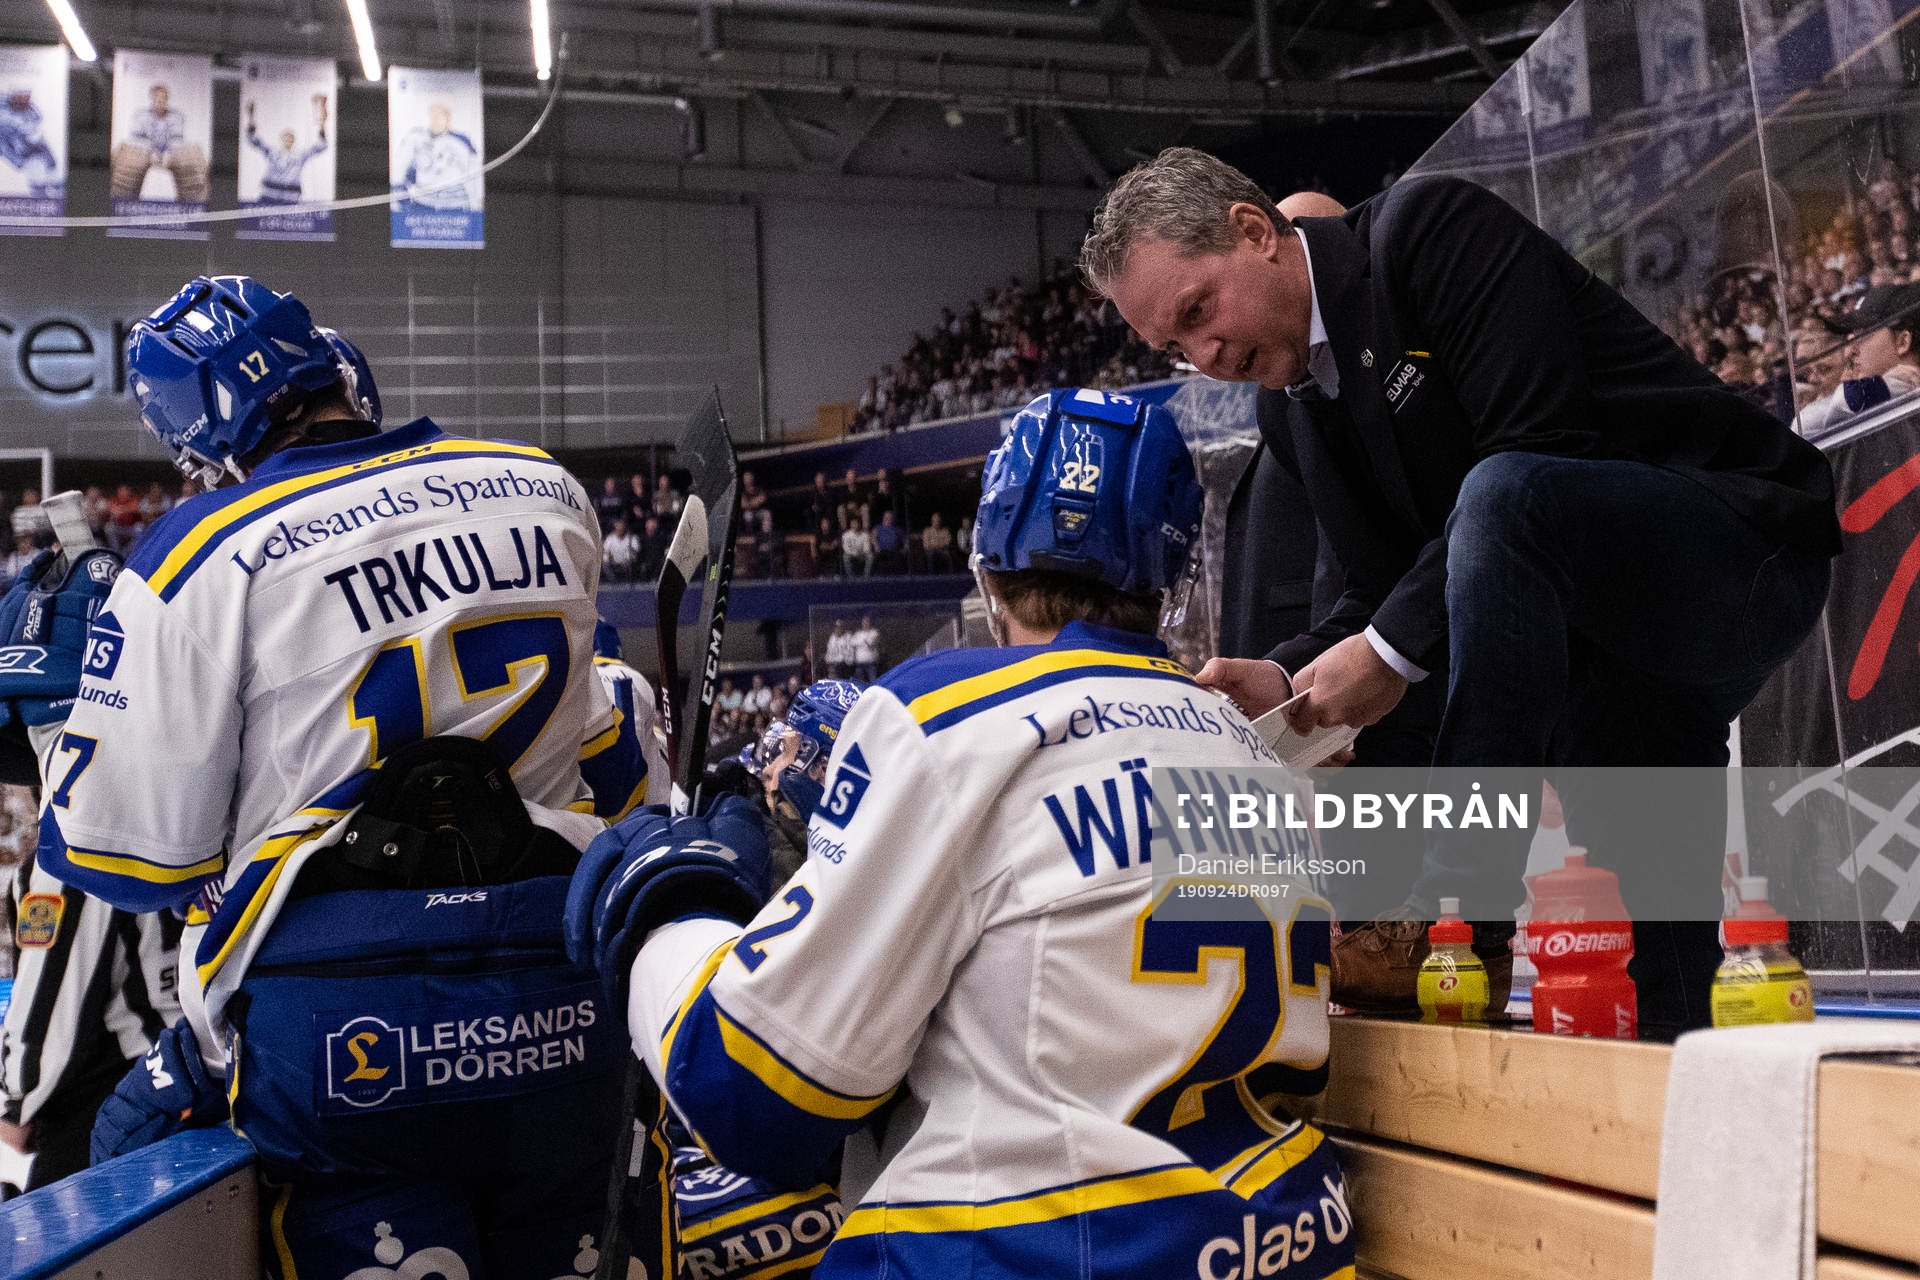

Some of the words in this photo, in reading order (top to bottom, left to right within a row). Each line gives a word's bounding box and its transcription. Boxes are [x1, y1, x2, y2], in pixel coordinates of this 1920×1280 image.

[238, 350, 270, 383] 17
[1386, 363, 1417, 402] ELMAB
[181, 412, 208, 443] CCM
[1058, 460, 1101, 494] 22
[230, 487, 420, 577] Leksands
[422, 469, 584, 515] Sparbank
[323, 525, 568, 634] TRKULJA
[702, 628, 722, 706] CCM
[346, 610, 571, 777] 17
[661, 686, 673, 735] CCM
[1021, 696, 1222, 748] Leksands
[424, 890, 488, 910] TACKS
[409, 999, 597, 1054] LEKSANDS
[425, 1034, 586, 1087] DÖRREN
